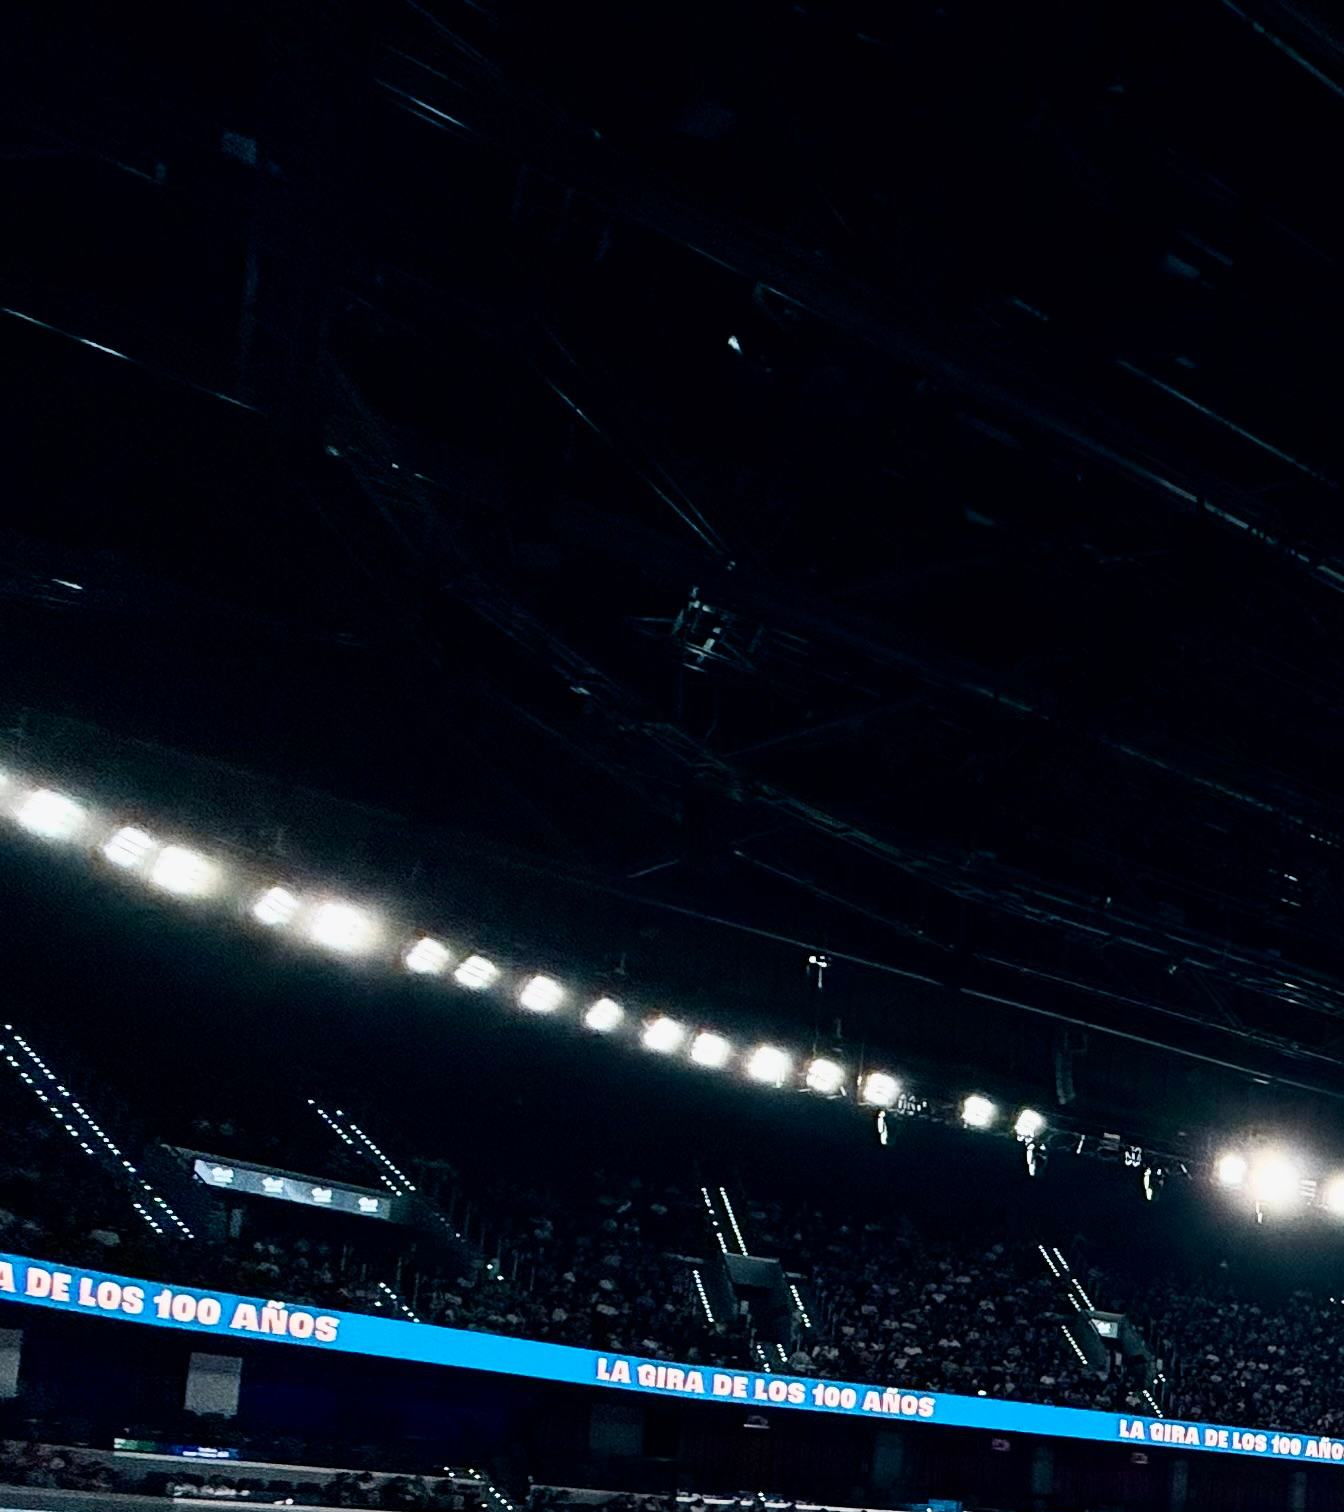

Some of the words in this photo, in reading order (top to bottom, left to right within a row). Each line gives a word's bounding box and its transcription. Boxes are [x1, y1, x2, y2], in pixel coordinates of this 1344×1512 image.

[25, 1266, 72, 1301] DE
[78, 1276, 145, 1315] LOS
[153, 1288, 221, 1326] 100
[229, 1299, 341, 1343] AÑOS
[596, 1357, 631, 1384] LA
[637, 1363, 704, 1394] GIRA
[713, 1374, 749, 1399] DE
[753, 1378, 806, 1404] LOS
[812, 1383, 857, 1409] 100
[862, 1387, 936, 1417] AÑOS
[1119, 1418, 1145, 1440] LA
[1150, 1423, 1200, 1446] GIRA
[1204, 1428, 1229, 1449] DE
[1232, 1431, 1267, 1453] LOS
[1271, 1434, 1301, 1456] 100
